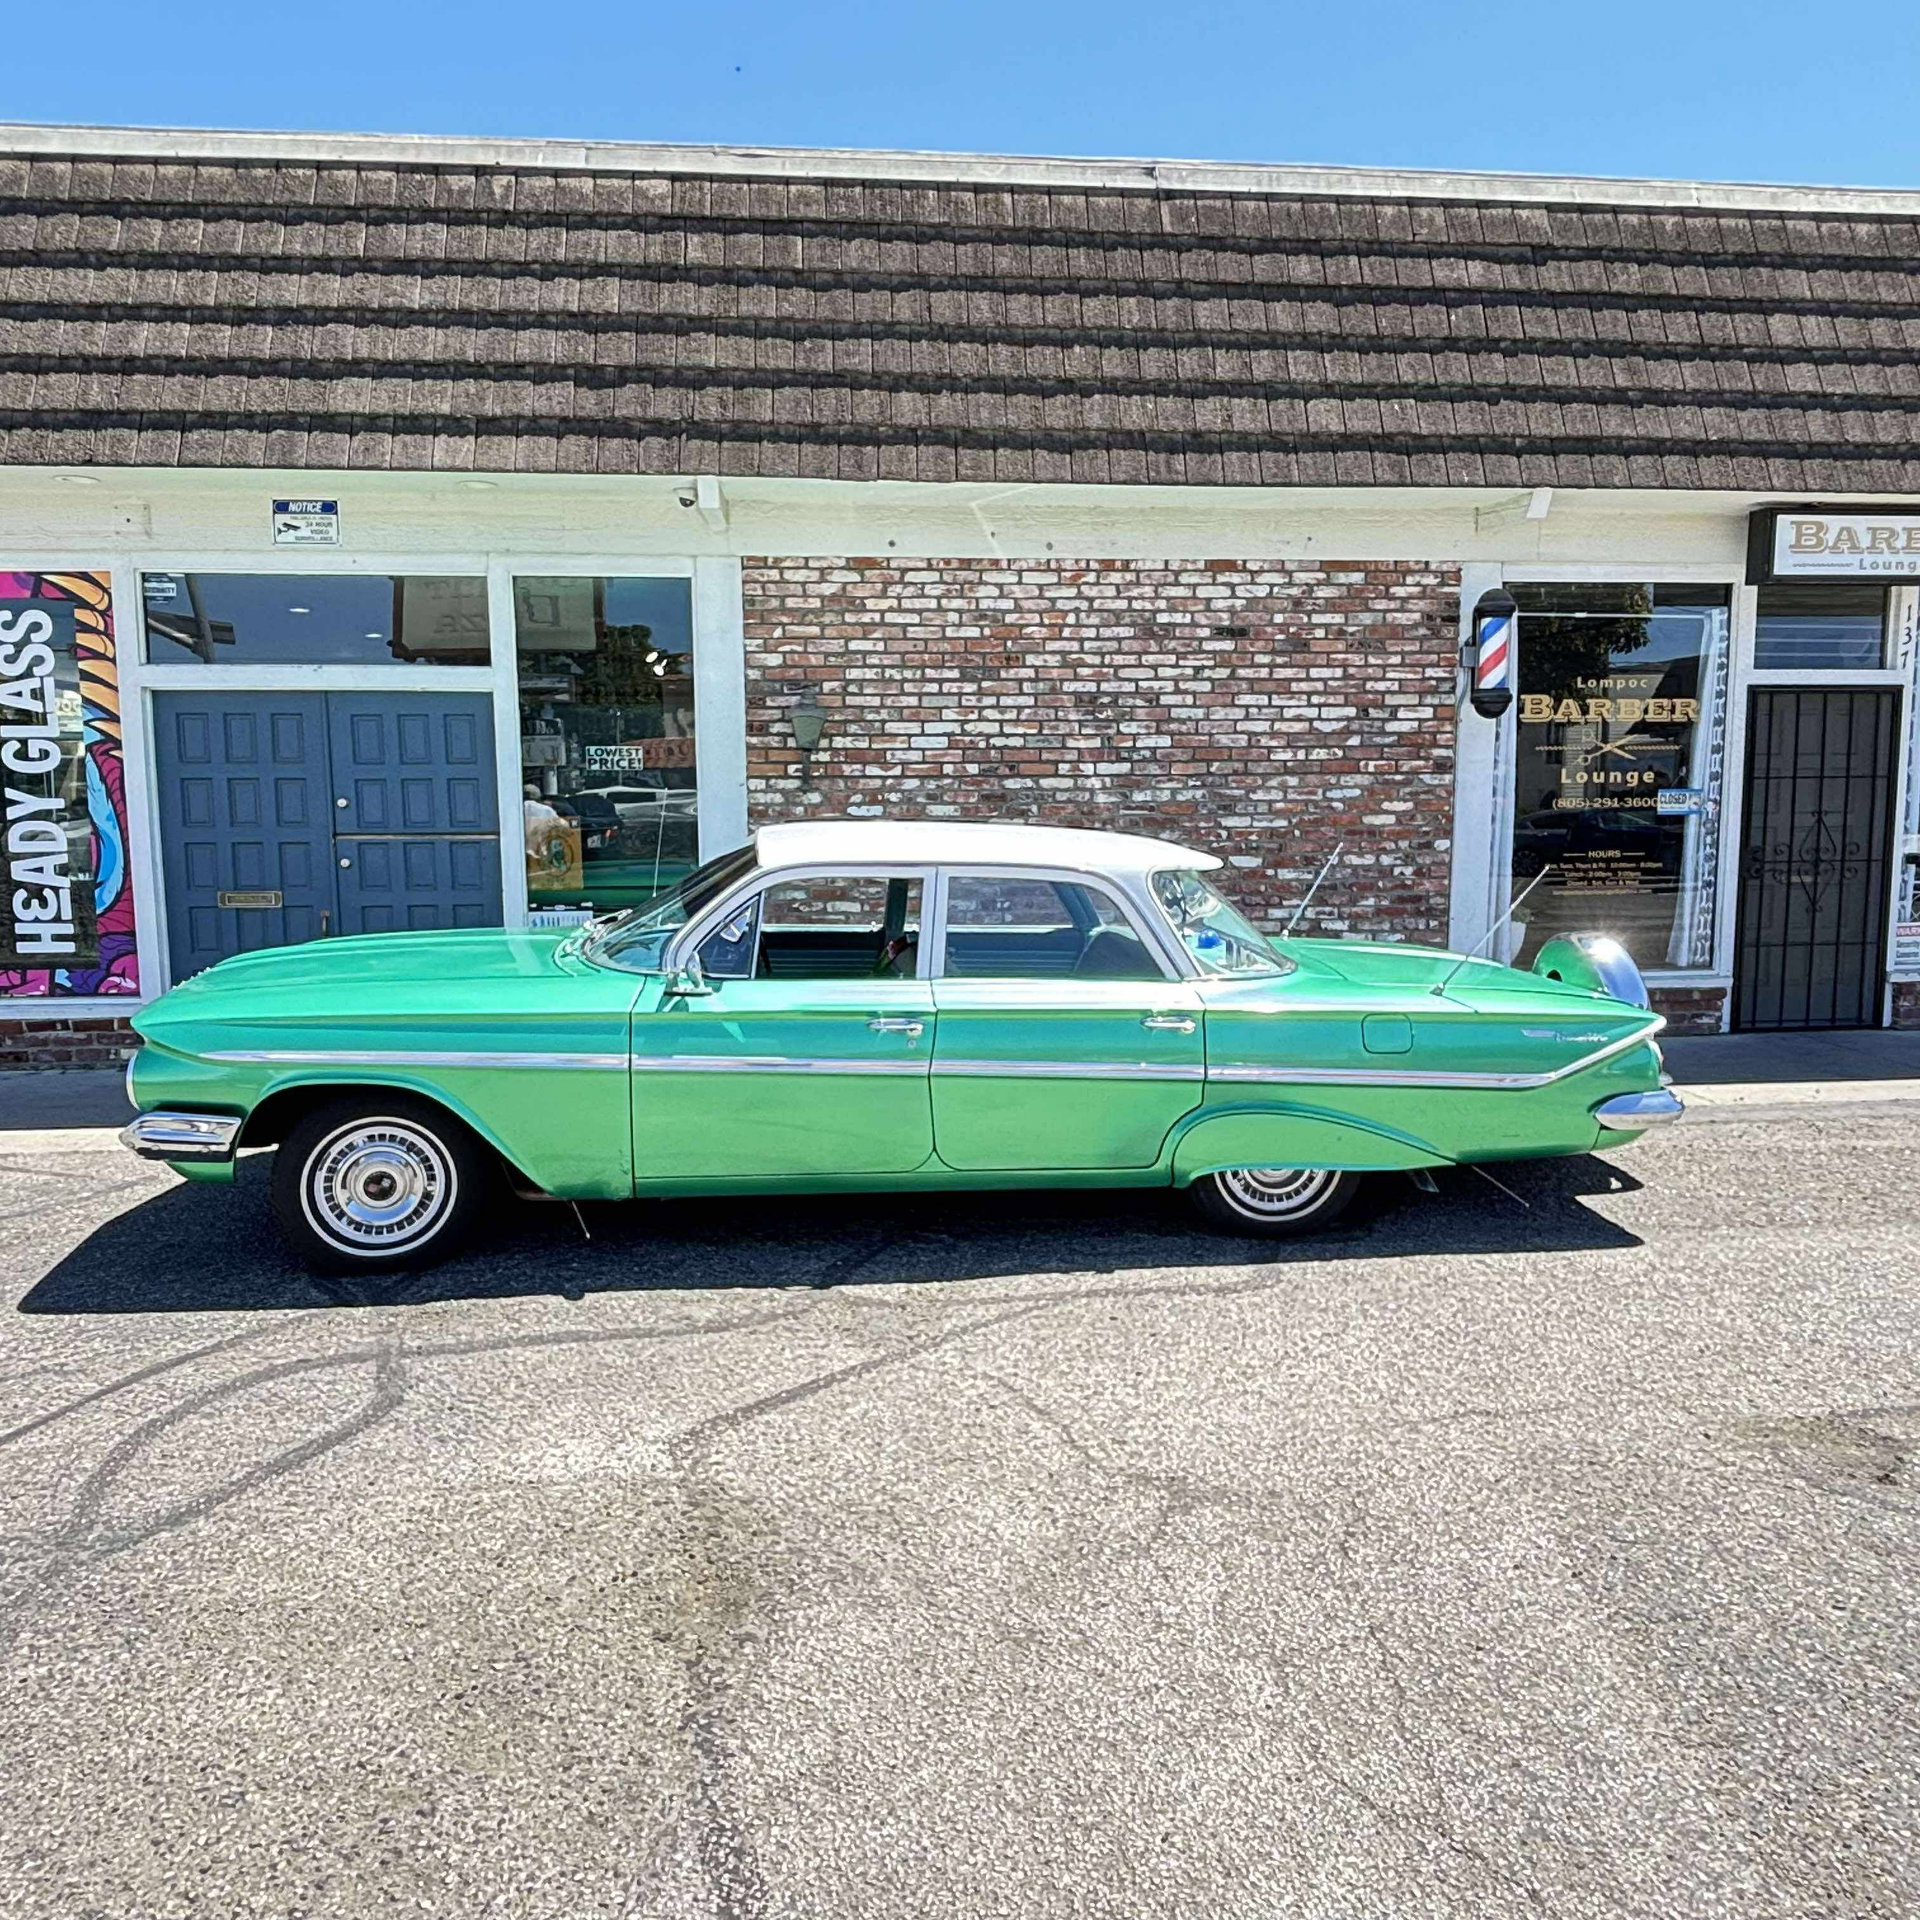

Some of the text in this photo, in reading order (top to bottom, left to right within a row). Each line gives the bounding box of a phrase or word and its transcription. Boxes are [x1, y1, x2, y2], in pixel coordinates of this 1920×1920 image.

[288, 501, 323, 512] NOTICE
[1577, 676, 1648, 690] Lompoc
[0, 609, 61, 774] GLASS
[1519, 694, 1698, 723] BARBER
[587, 747, 642, 757] LOWEST
[588, 758, 642, 770] PRICE!
[1561, 768, 1655, 786] Lounge
[1588, 850, 1621, 858] HOURS
